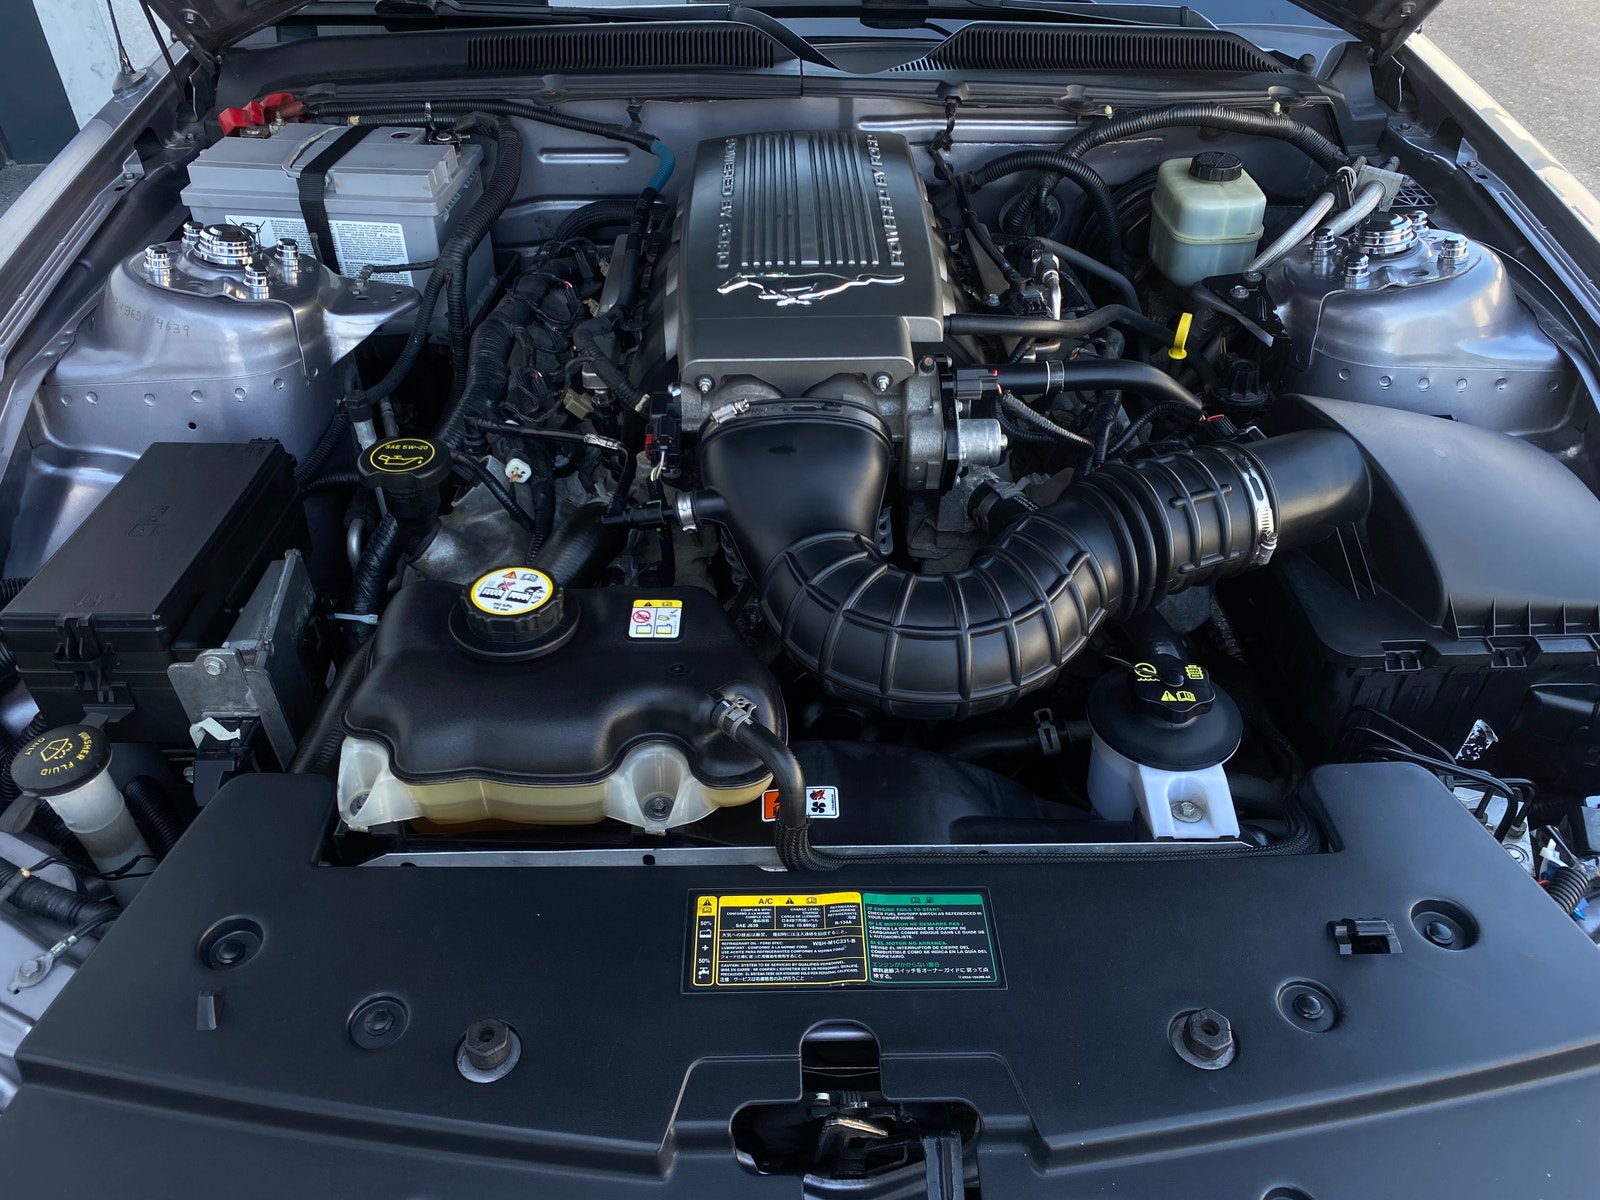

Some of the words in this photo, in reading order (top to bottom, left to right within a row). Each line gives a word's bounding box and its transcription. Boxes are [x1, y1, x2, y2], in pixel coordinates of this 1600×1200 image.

[871, 168, 888, 187] BY
[719, 199, 733, 220] BY
[877, 190, 904, 267] POWERED
[25, 738, 46, 756] ONLY
[76, 731, 92, 760] WASHER
[40, 761, 74, 776] FLUID
